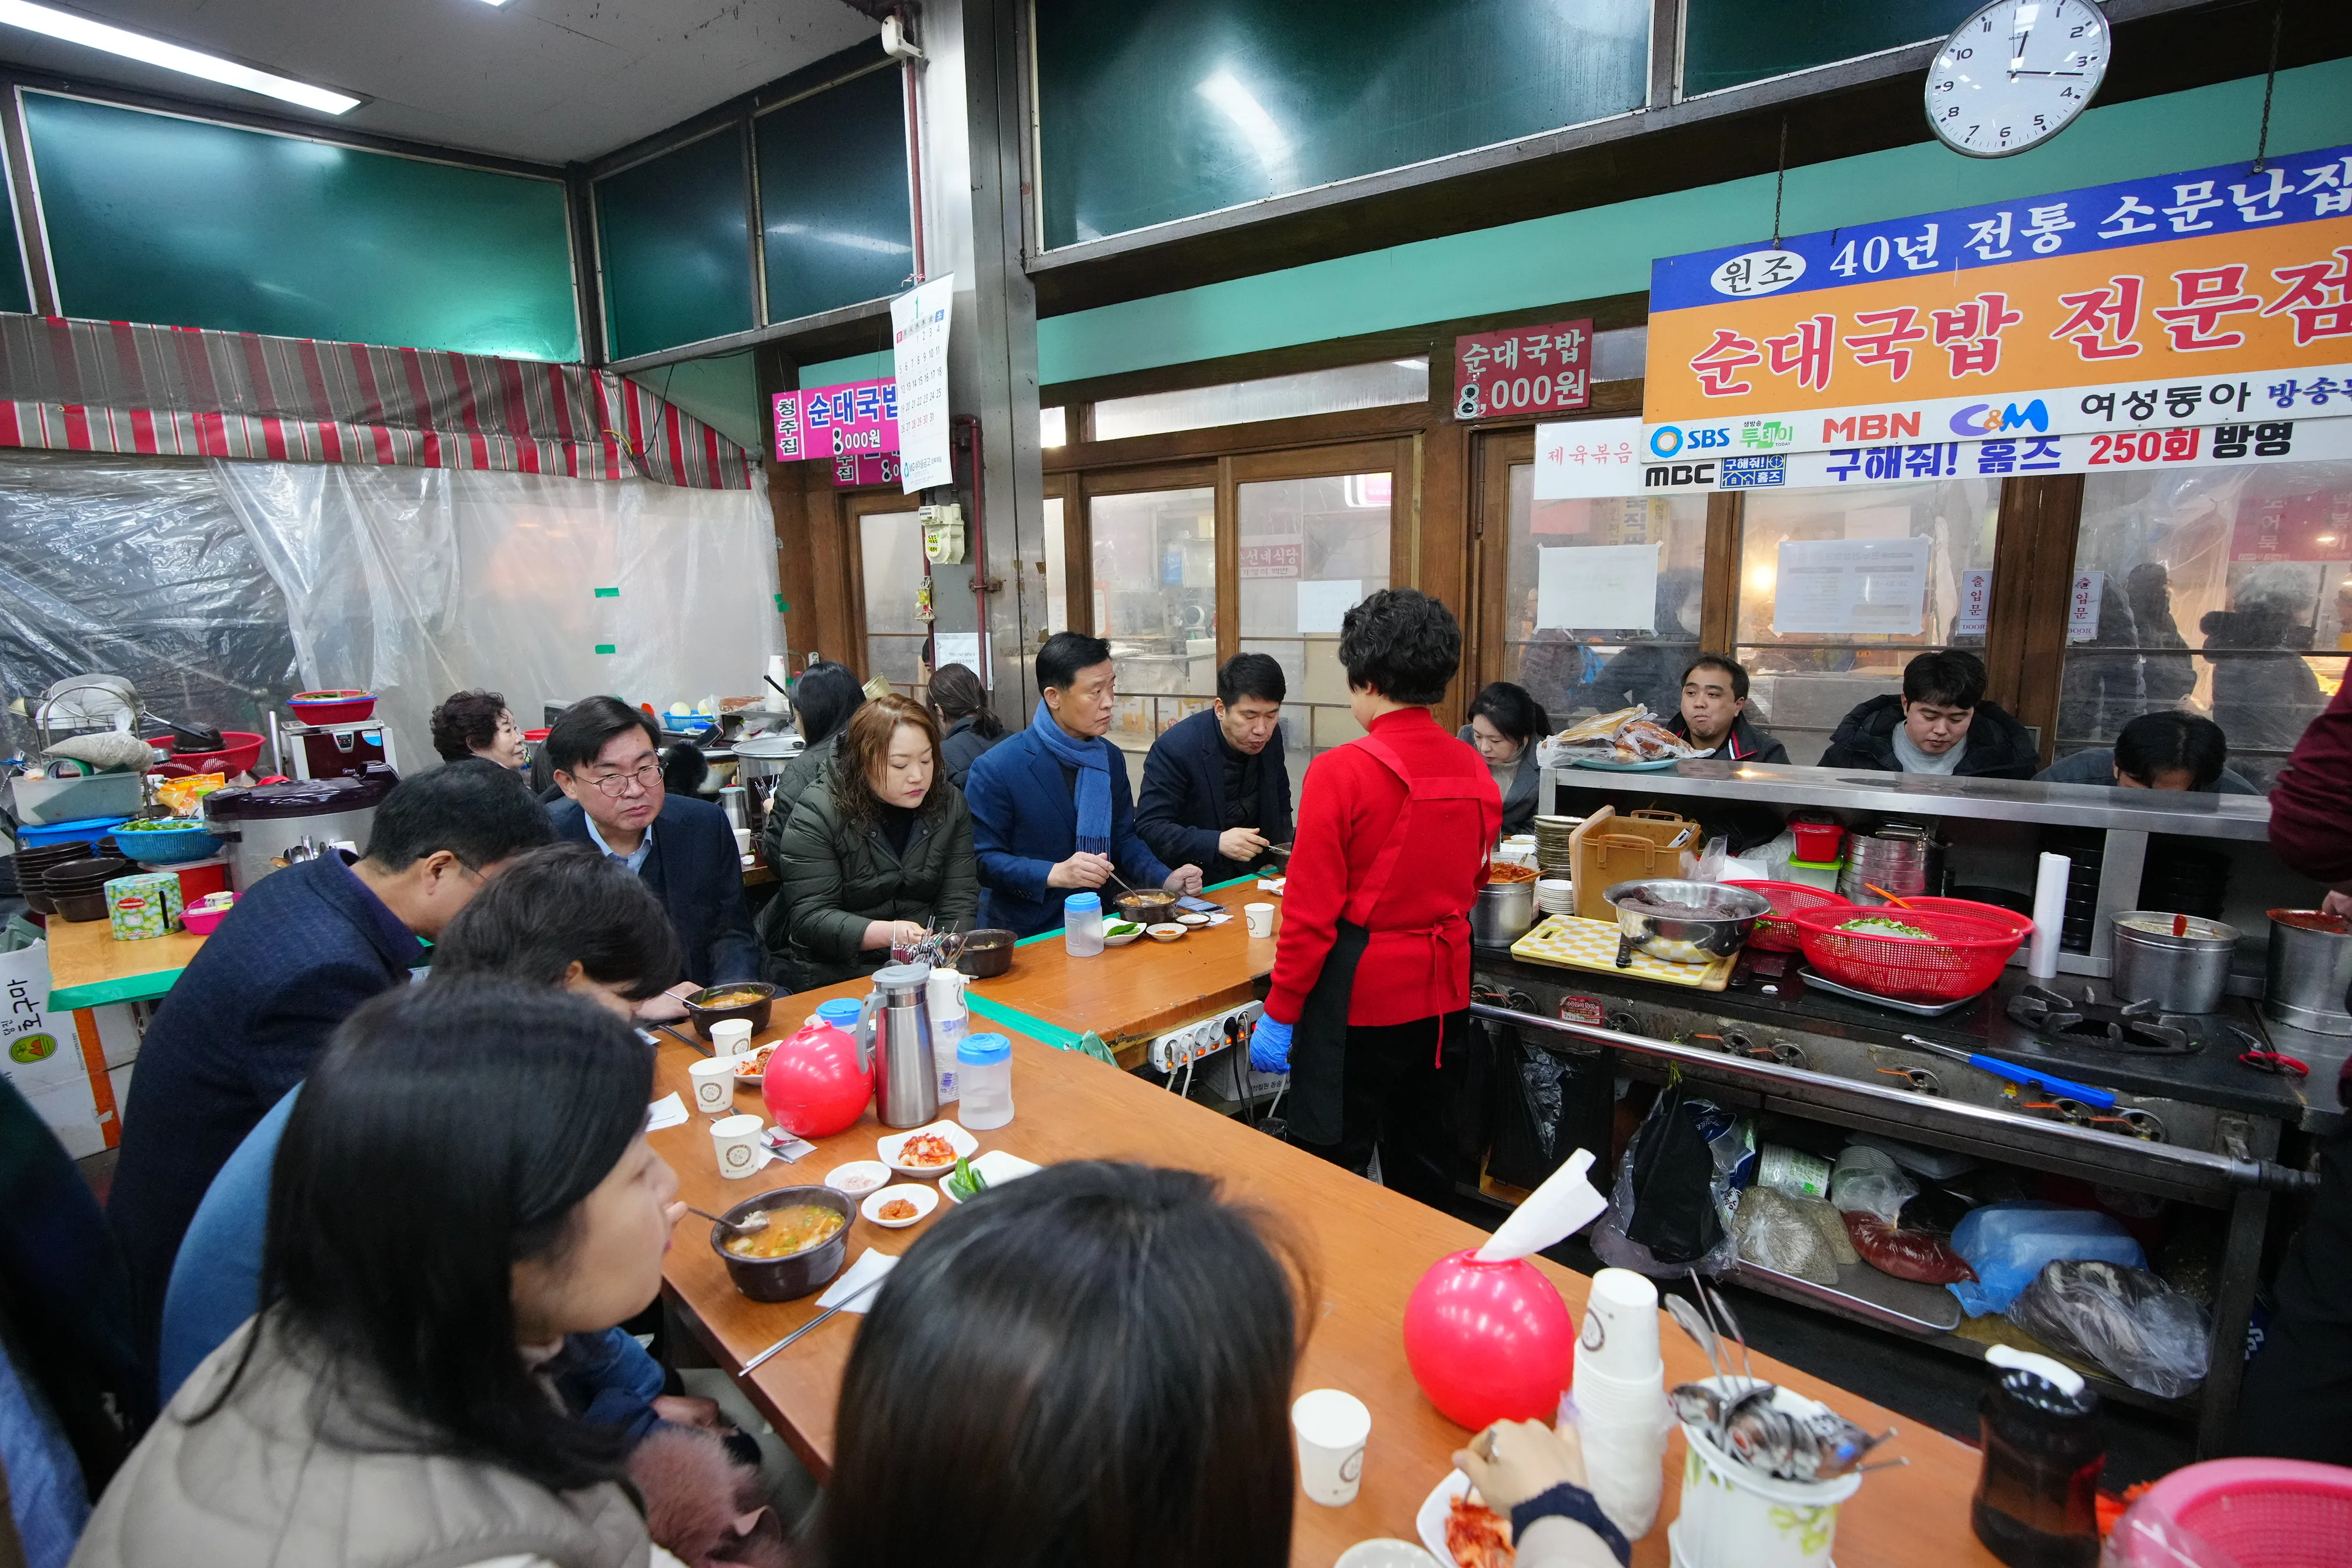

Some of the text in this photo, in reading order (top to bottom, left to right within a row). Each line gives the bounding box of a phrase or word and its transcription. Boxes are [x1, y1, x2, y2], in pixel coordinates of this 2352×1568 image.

[2056, 7, 2060, 18] 1
[1983, 21, 1992, 32] 11
[2070, 26, 2084, 38] 2
[1956, 48, 1973, 61] 10
[2076, 56, 2088, 67] 3
[1943, 81, 1954, 92] 9
[2060, 86, 2073, 98] 4
[1948, 106, 1959, 117] 8
[2033, 114, 2044, 126] 5
[1968, 125, 1980, 136] 7
[1999, 126, 2011, 137] 6
[1720, 255, 1795, 295] 원조
[1830, 224, 1939, 278] 40년
[1964, 202, 2075, 260] 전통
[915, 296, 918, 319] 1
[1690, 245, 2352, 397] 순대국밥 전문점
[1462, 329, 1585, 373] 순대국밥
[1456, 369, 1585, 420] 8,000원
[2081, 377, 2352, 422] 여성동아 방송
[777, 399, 798, 454] 청주집
[1743, 420, 1762, 429] 생방송
[1822, 412, 1921, 444] MBN
[1949, 399, 2049, 437] C&M
[1688, 427, 1730, 449] SBS
[1740, 424, 1793, 448] 투데이
[1548, 442, 1633, 467] 제육볶음
[1826, 422, 2293, 482] 구해줘! 홈즈 250회 방영
[1725, 457, 1765, 470] 구해줘!
[1645, 463, 1715, 487] MBC
[1756, 471, 1782, 484] 홈즈
[1969, 576, 1984, 616] 출입문
[2074, 577, 2092, 619] 출입문
